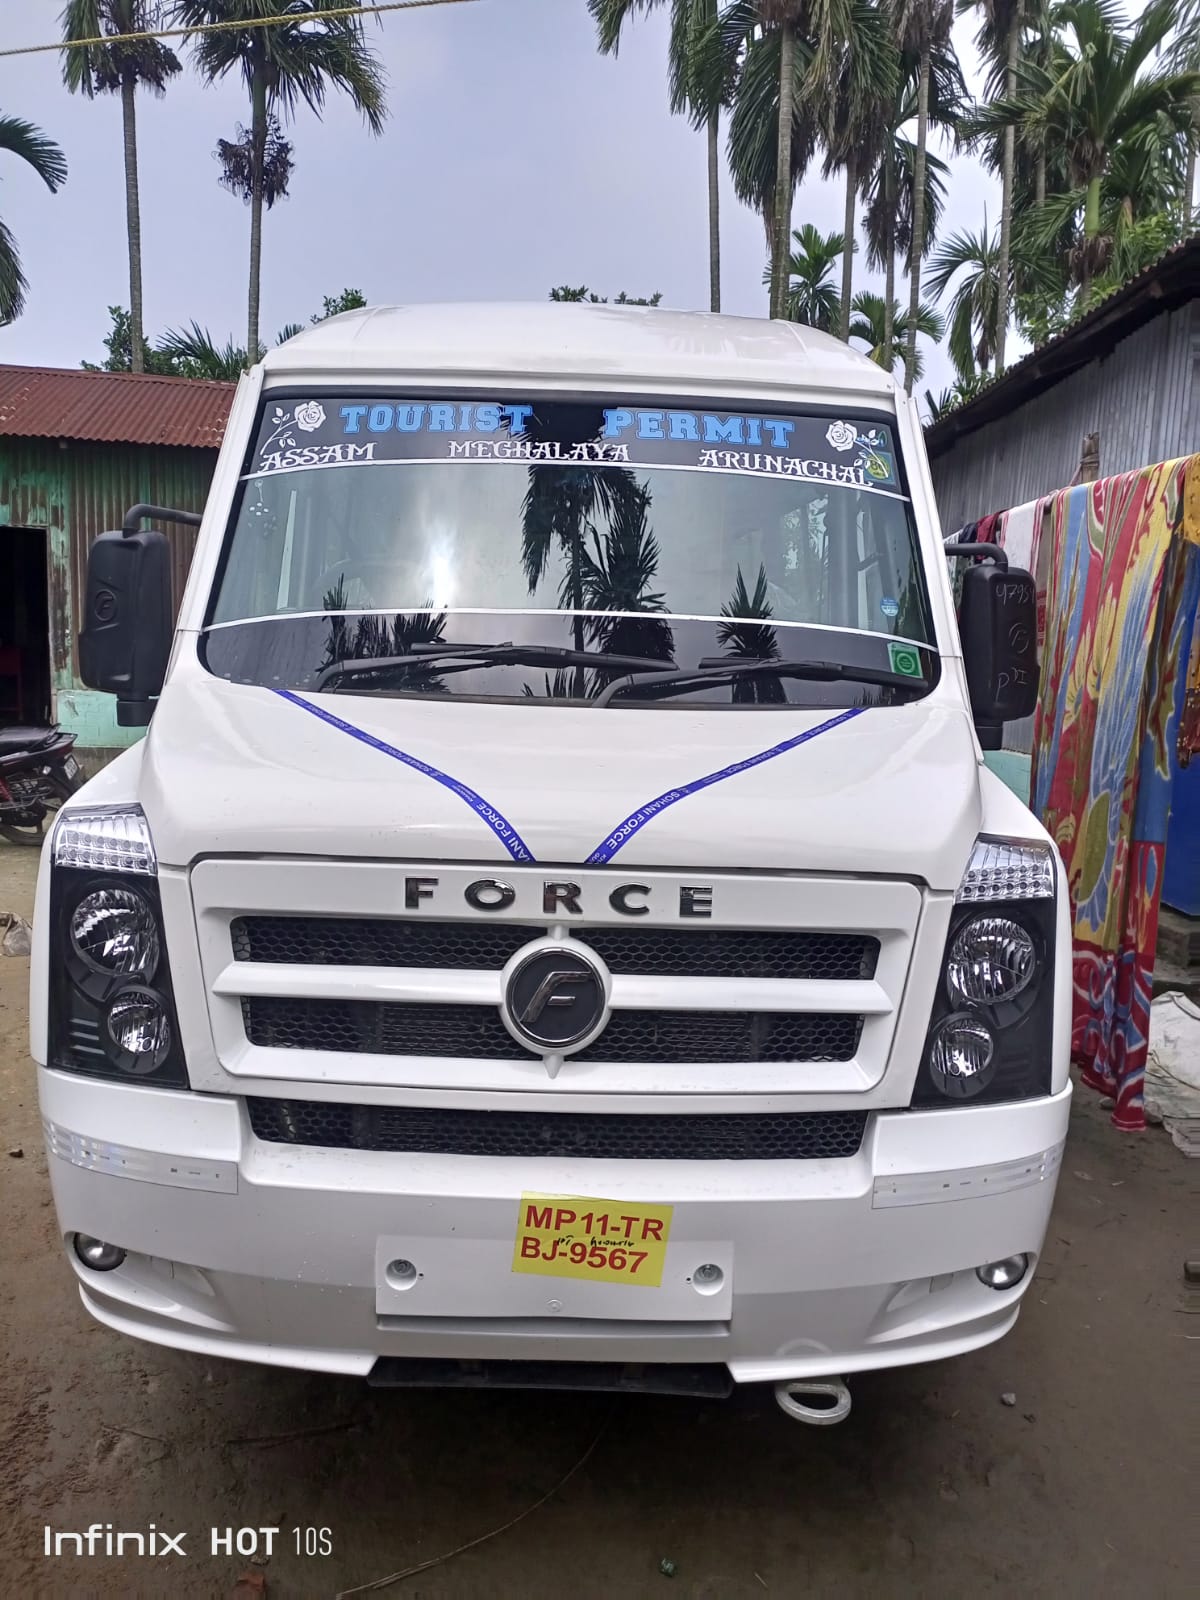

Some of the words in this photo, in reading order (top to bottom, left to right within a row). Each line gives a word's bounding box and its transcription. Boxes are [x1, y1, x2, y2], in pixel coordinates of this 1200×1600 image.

[340, 404, 533, 433] TOURIST
[602, 408, 795, 448] PERMIT
[258, 442, 378, 473] ASSAM
[448, 440, 632, 462] MEGHALAYA
[698, 449, 874, 487] ARUNACHAL
[476, 802, 512, 838] FORCE
[644, 790, 681, 815] SOHANI
[606, 813, 645, 851] FORCE
[404, 877, 713, 918] FORCE
[520, 1236, 649, 1273] BJ-9567
